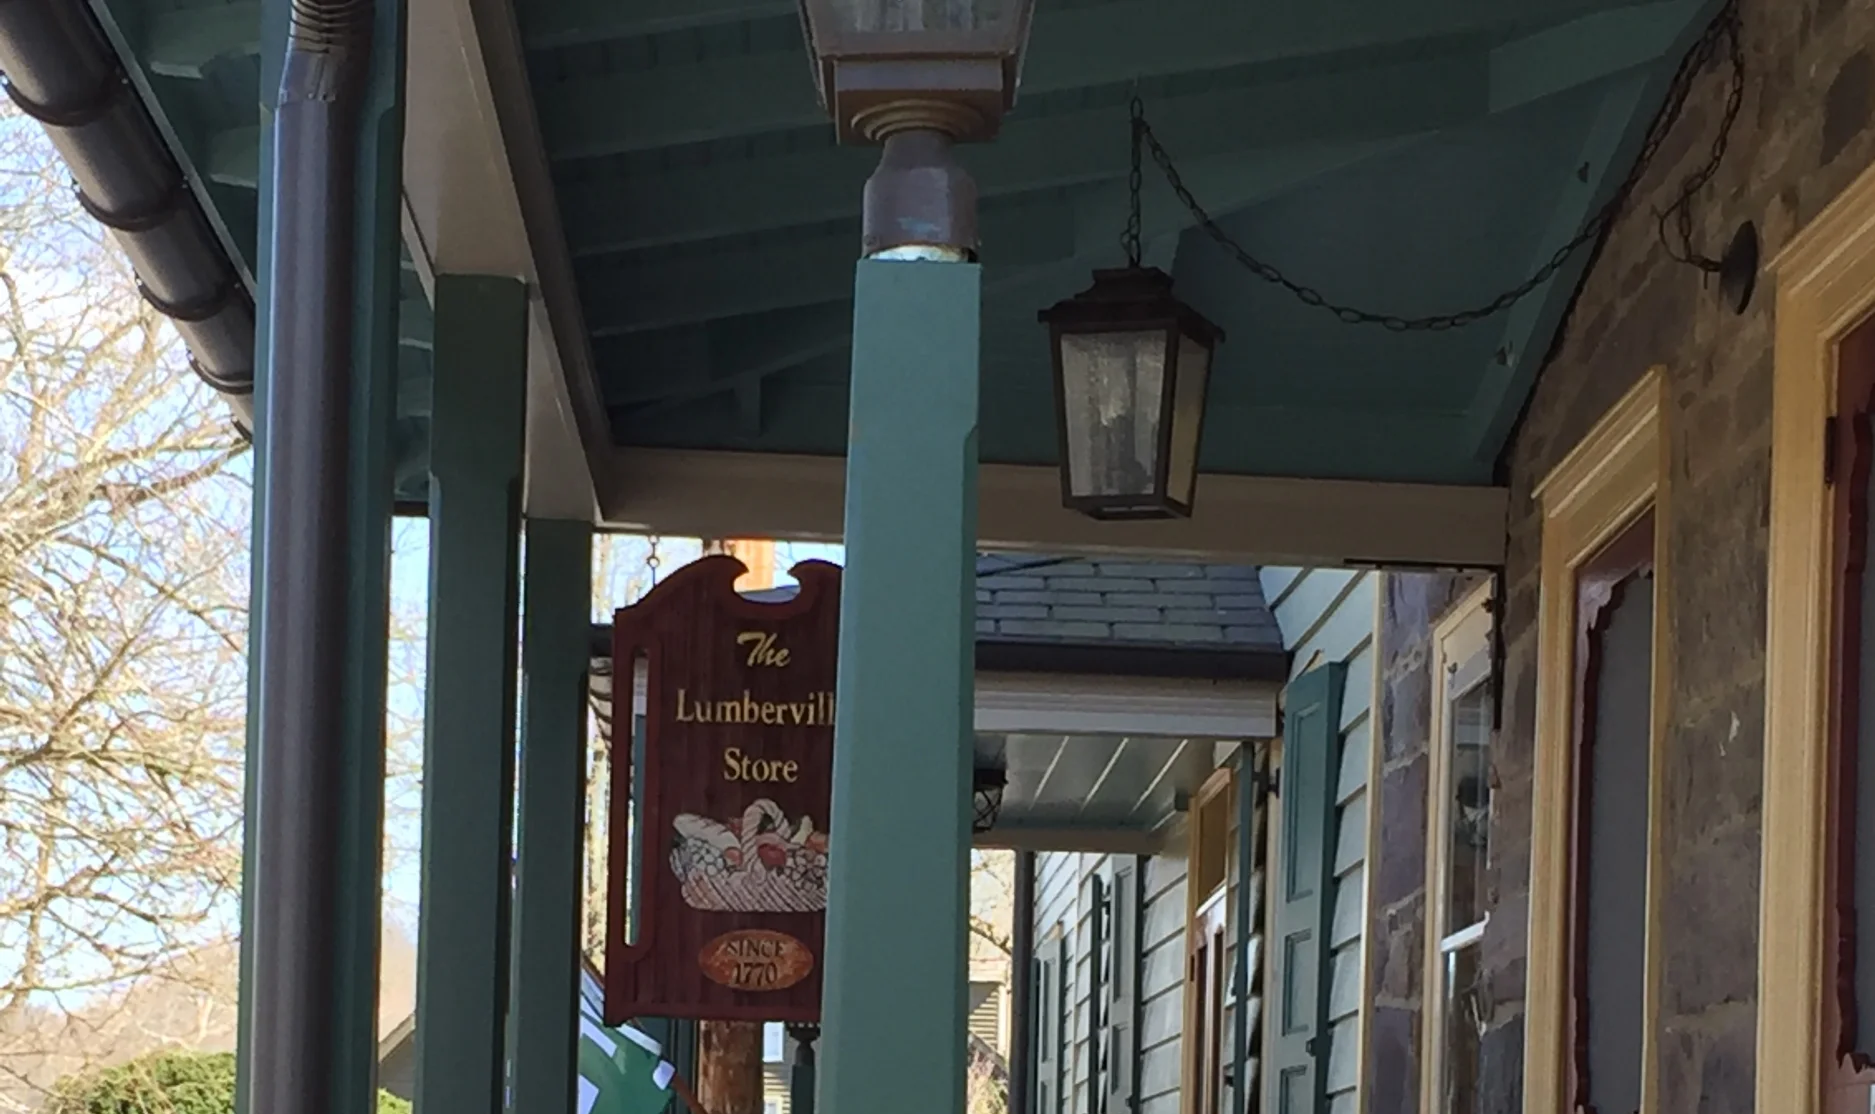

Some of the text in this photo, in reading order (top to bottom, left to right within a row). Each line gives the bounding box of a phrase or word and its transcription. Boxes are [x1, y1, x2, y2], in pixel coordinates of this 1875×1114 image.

[736, 631, 791, 667] The
[676, 688, 835, 725] Lumbervill
[723, 747, 799, 783] Store
[725, 939, 786, 957] SINCE
[733, 962, 778, 986] 1770
